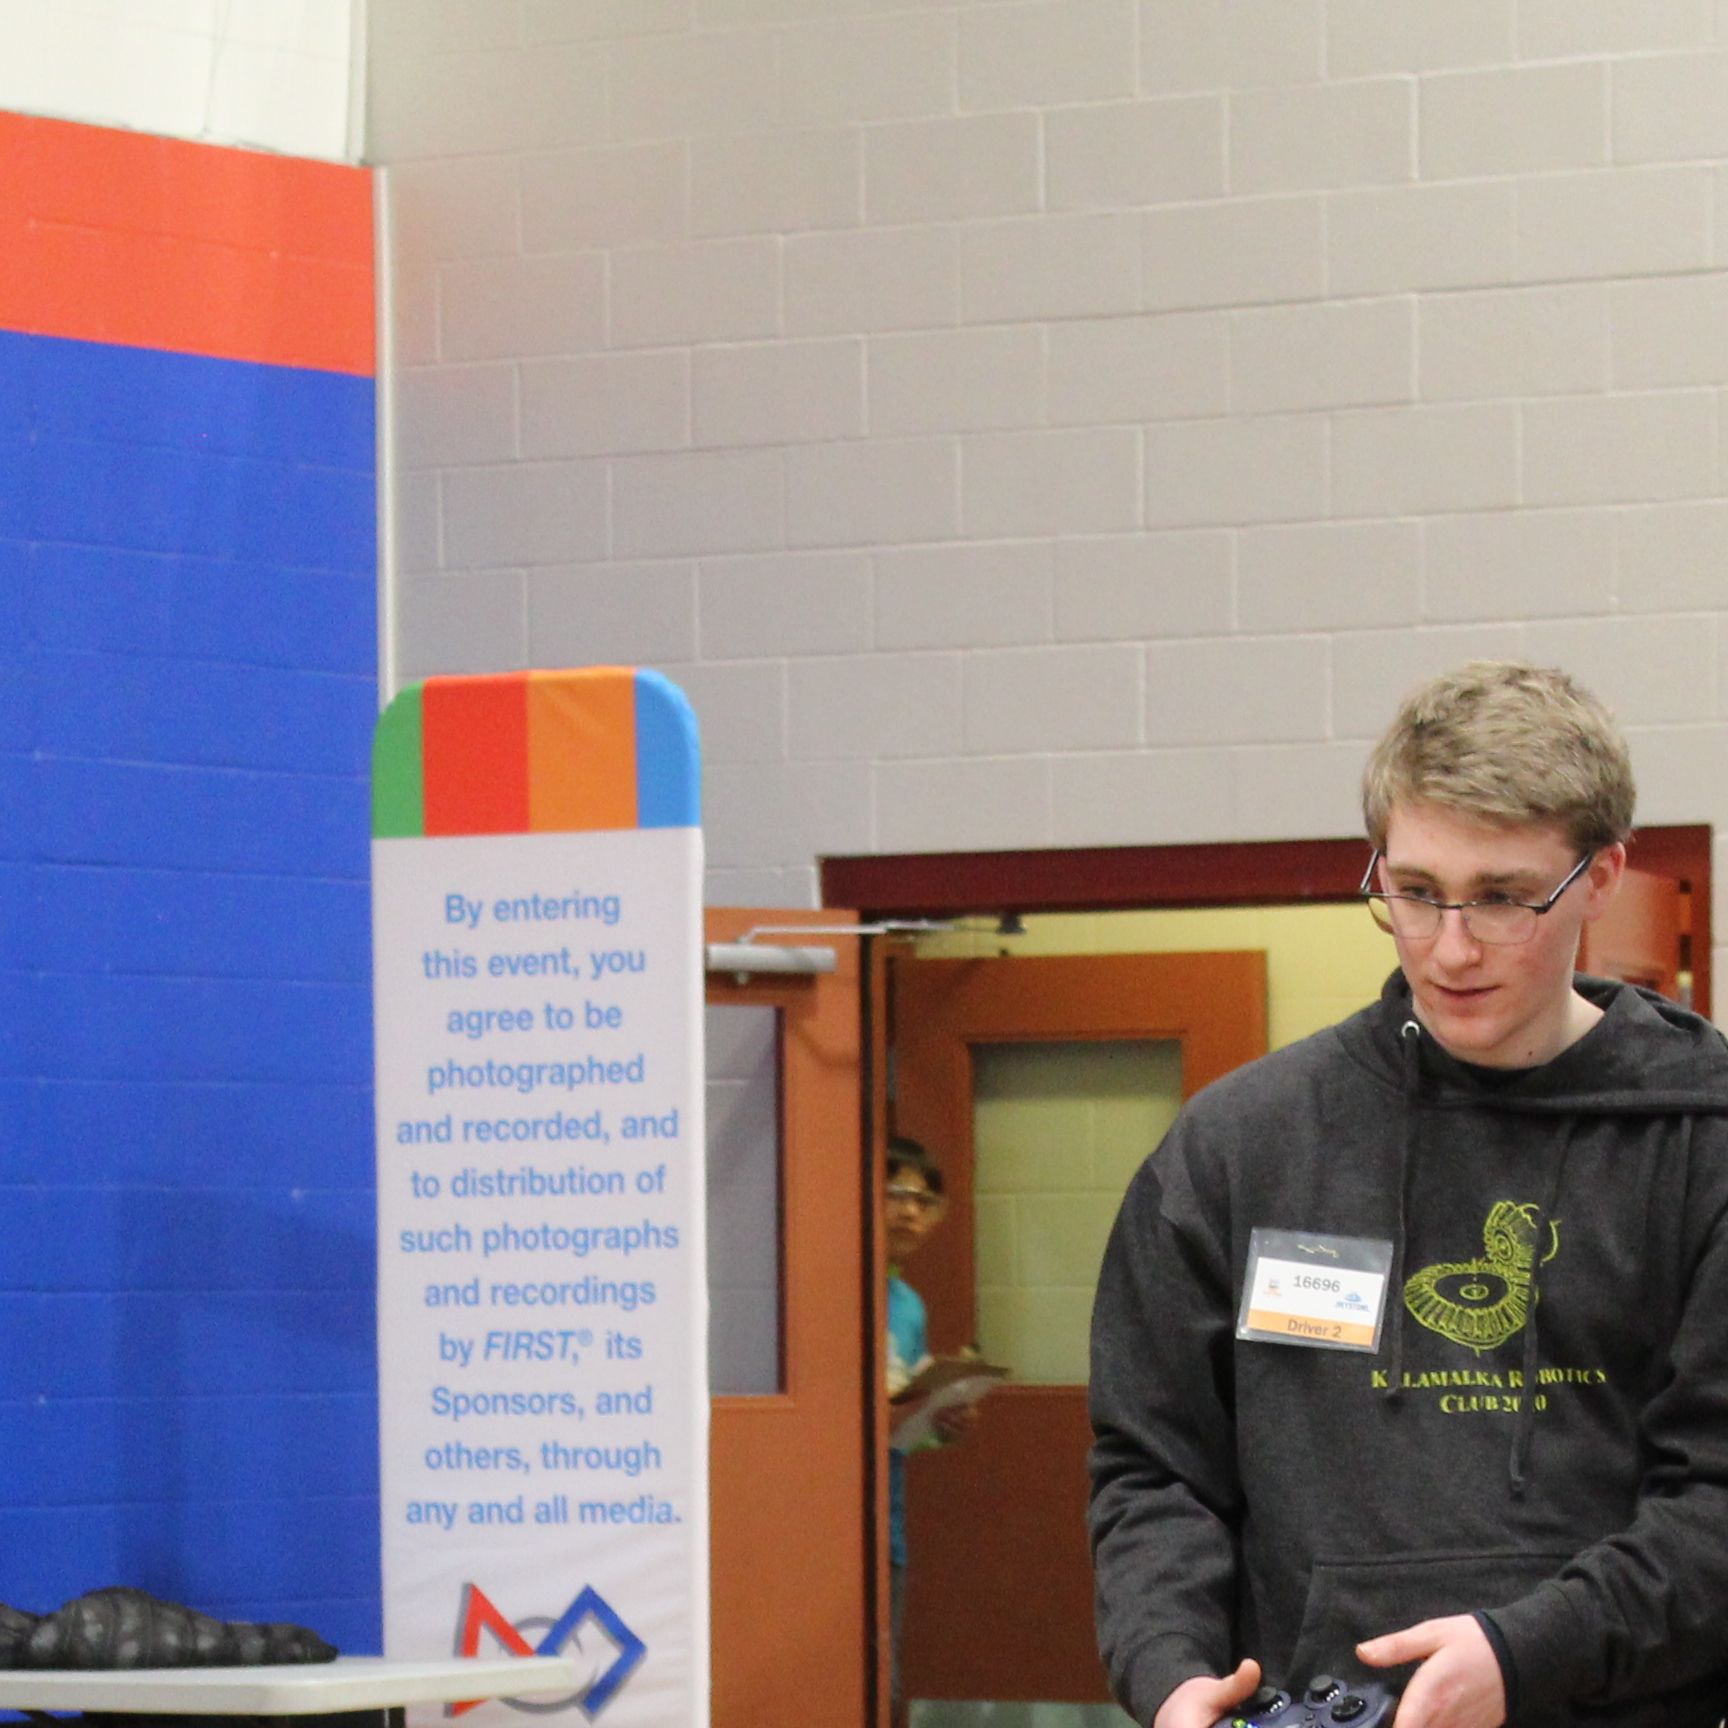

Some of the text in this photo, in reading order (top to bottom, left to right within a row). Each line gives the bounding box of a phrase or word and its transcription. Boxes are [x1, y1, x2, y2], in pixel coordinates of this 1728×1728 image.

[445, 891, 621, 928] By entering
[422, 949, 645, 980] this event, you
[447, 1003, 622, 1040] agree to be
[427, 1055, 645, 1094] photographed
[397, 1111, 679, 1145] and recorded, and
[411, 1165, 665, 1198] to distribution of
[400, 1222, 679, 1258] such photographs
[426, 1277, 656, 1312] and recordings
[1293, 1275, 1341, 1293] 16696
[1287, 1319, 1342, 1338] Driver 2
[439, 1333, 474, 1366] by
[606, 1333, 642, 1359] its
[1371, 1368, 1607, 1389] KLAMALKA RBOTICS
[432, 1385, 653, 1419] Sponsors, and
[1439, 1394, 1548, 1414] CLUB 200
[424, 1441, 662, 1477] others, through
[406, 1495, 683, 1531] any and all media.
